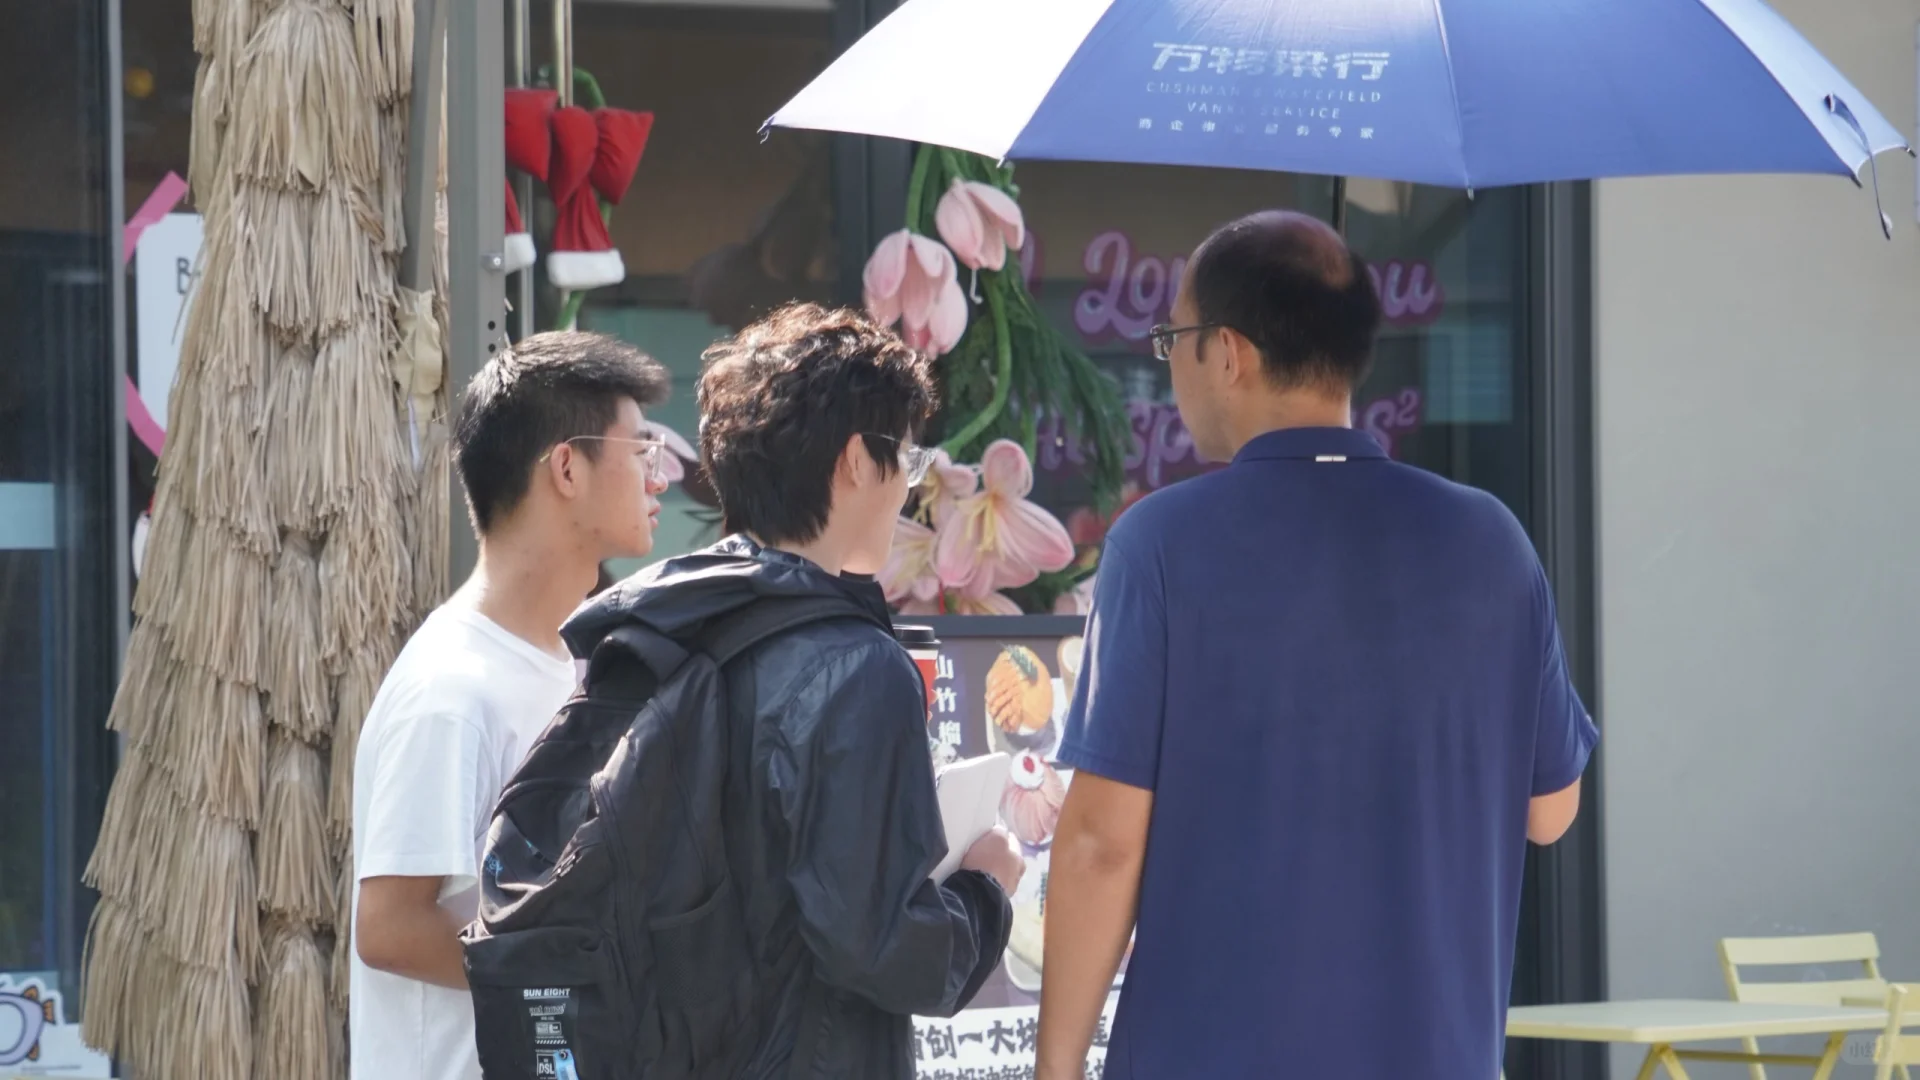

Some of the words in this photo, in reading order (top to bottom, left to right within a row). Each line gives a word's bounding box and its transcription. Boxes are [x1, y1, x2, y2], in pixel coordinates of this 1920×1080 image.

[1146, 82, 1240, 97] CUSHMAN
[523, 988, 542, 997] SUN
[543, 988, 571, 996] EIGHT
